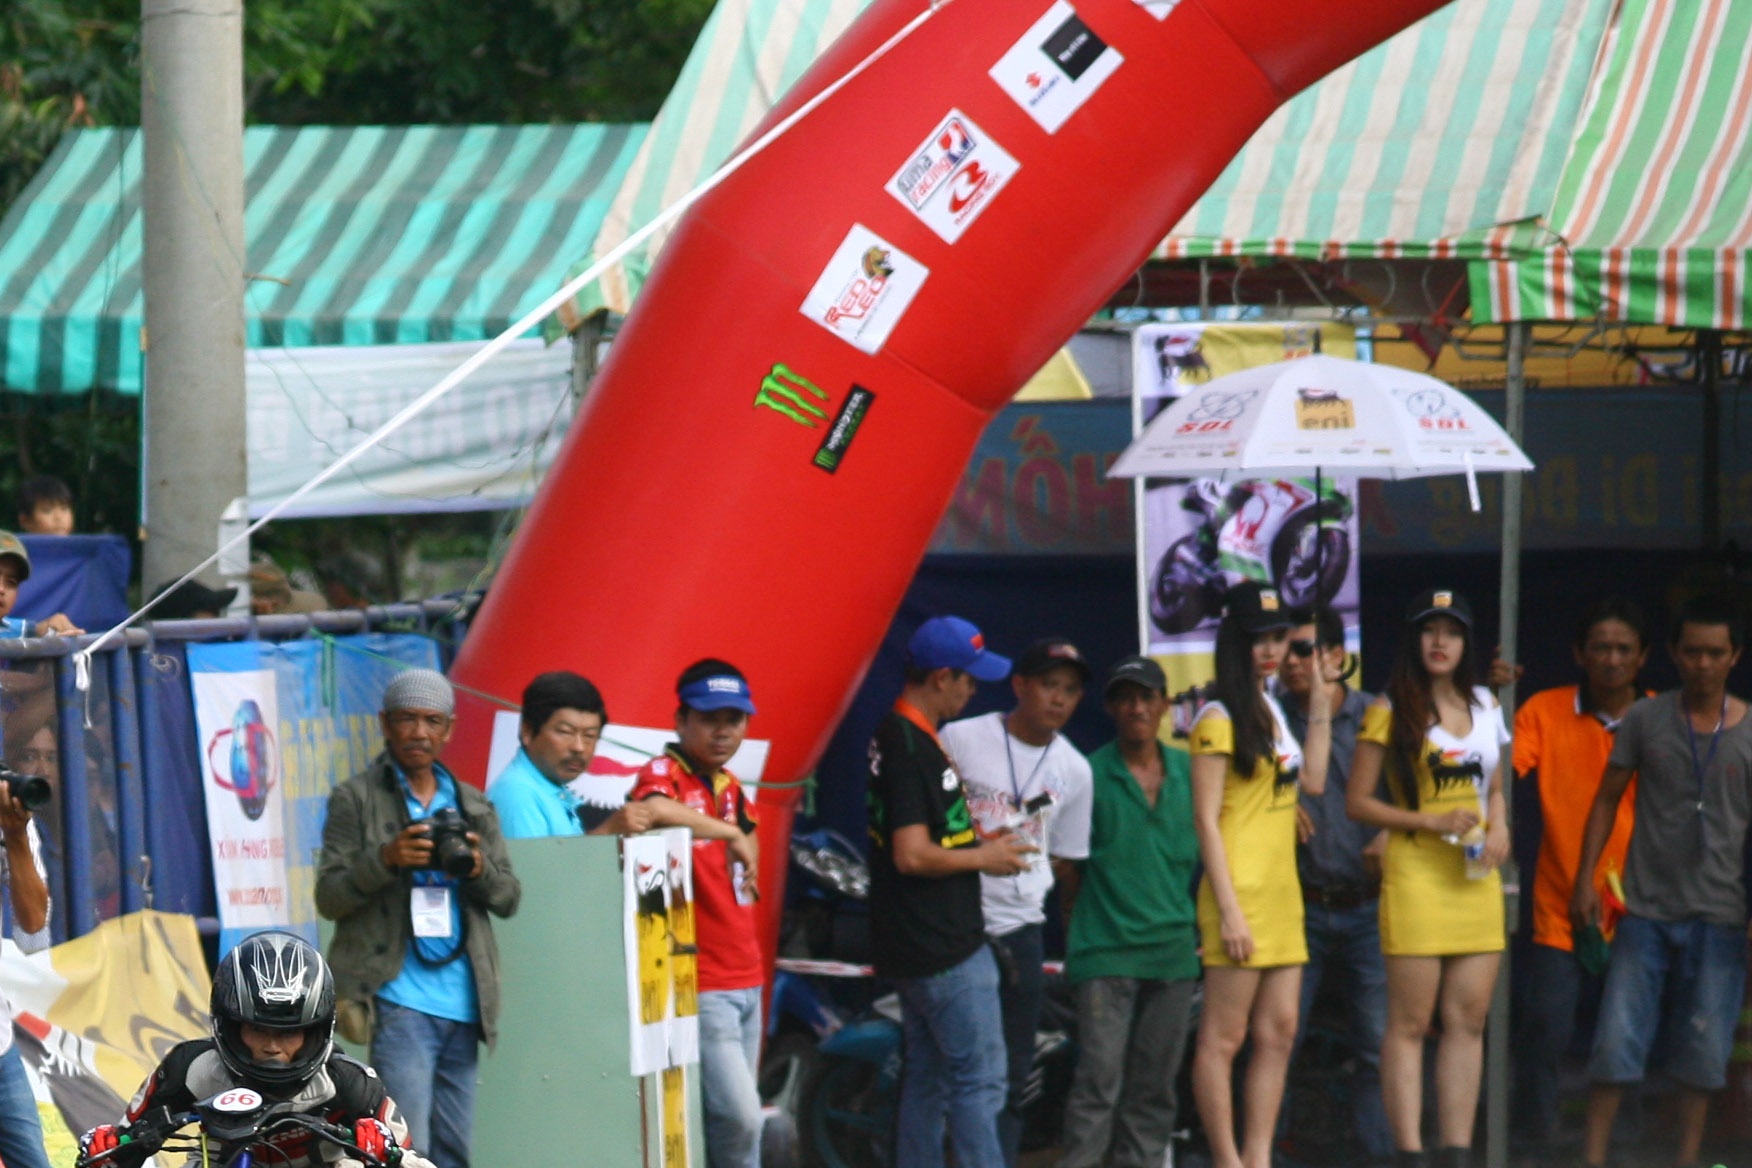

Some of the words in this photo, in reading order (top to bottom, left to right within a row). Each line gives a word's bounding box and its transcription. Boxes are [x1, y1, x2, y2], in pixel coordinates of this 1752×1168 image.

[911, 157, 955, 204] racing
[1302, 411, 1349, 430] eni
[220, 1093, 256, 1107] 66
